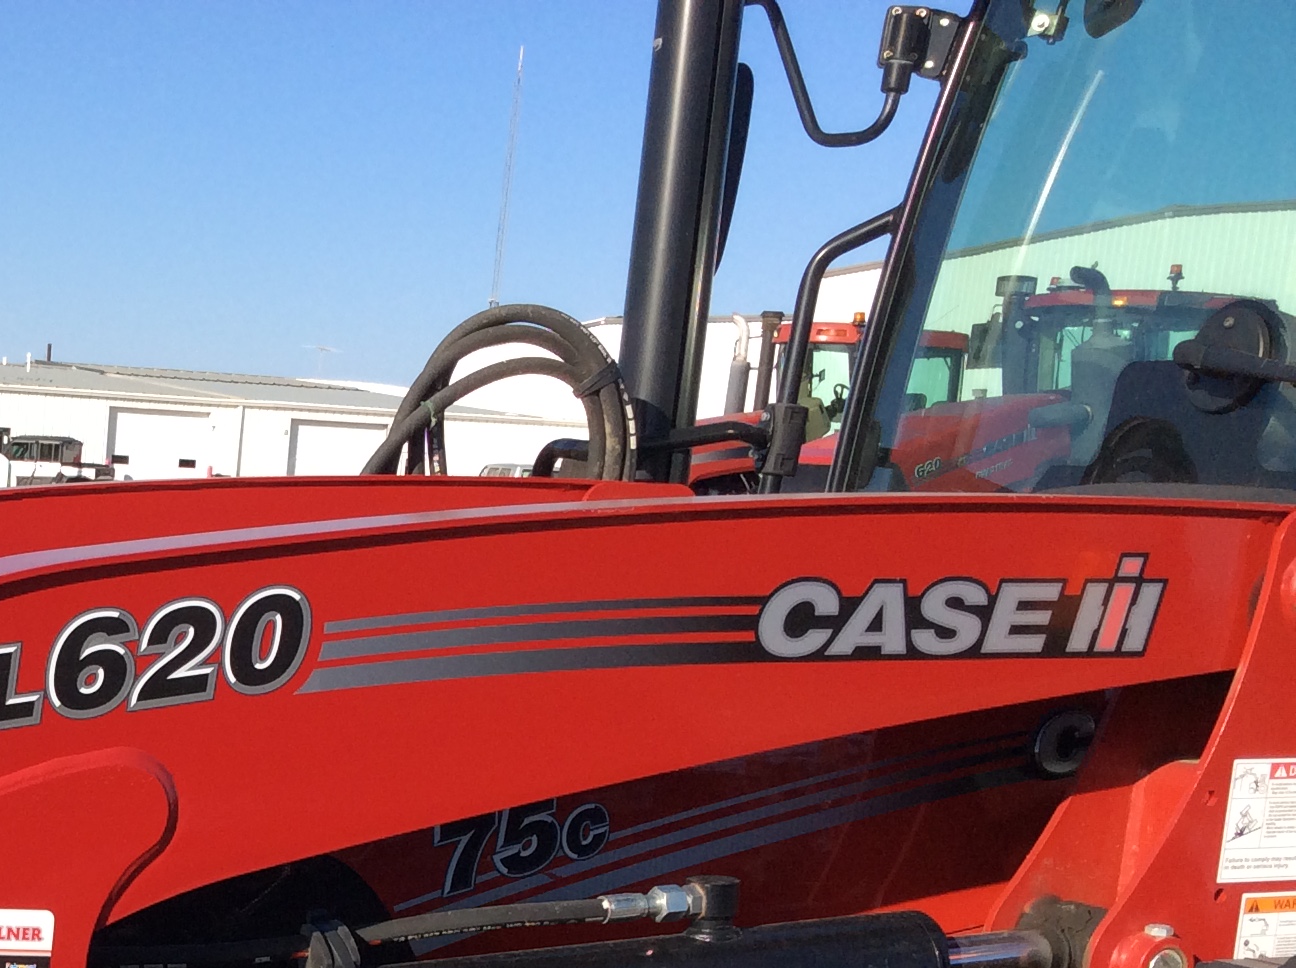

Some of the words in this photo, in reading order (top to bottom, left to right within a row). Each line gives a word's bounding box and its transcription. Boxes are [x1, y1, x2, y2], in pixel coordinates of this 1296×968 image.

[914, 456, 942, 478] 620
[757, 575, 1068, 658] CASE
[1064, 551, 1169, 658] IH
